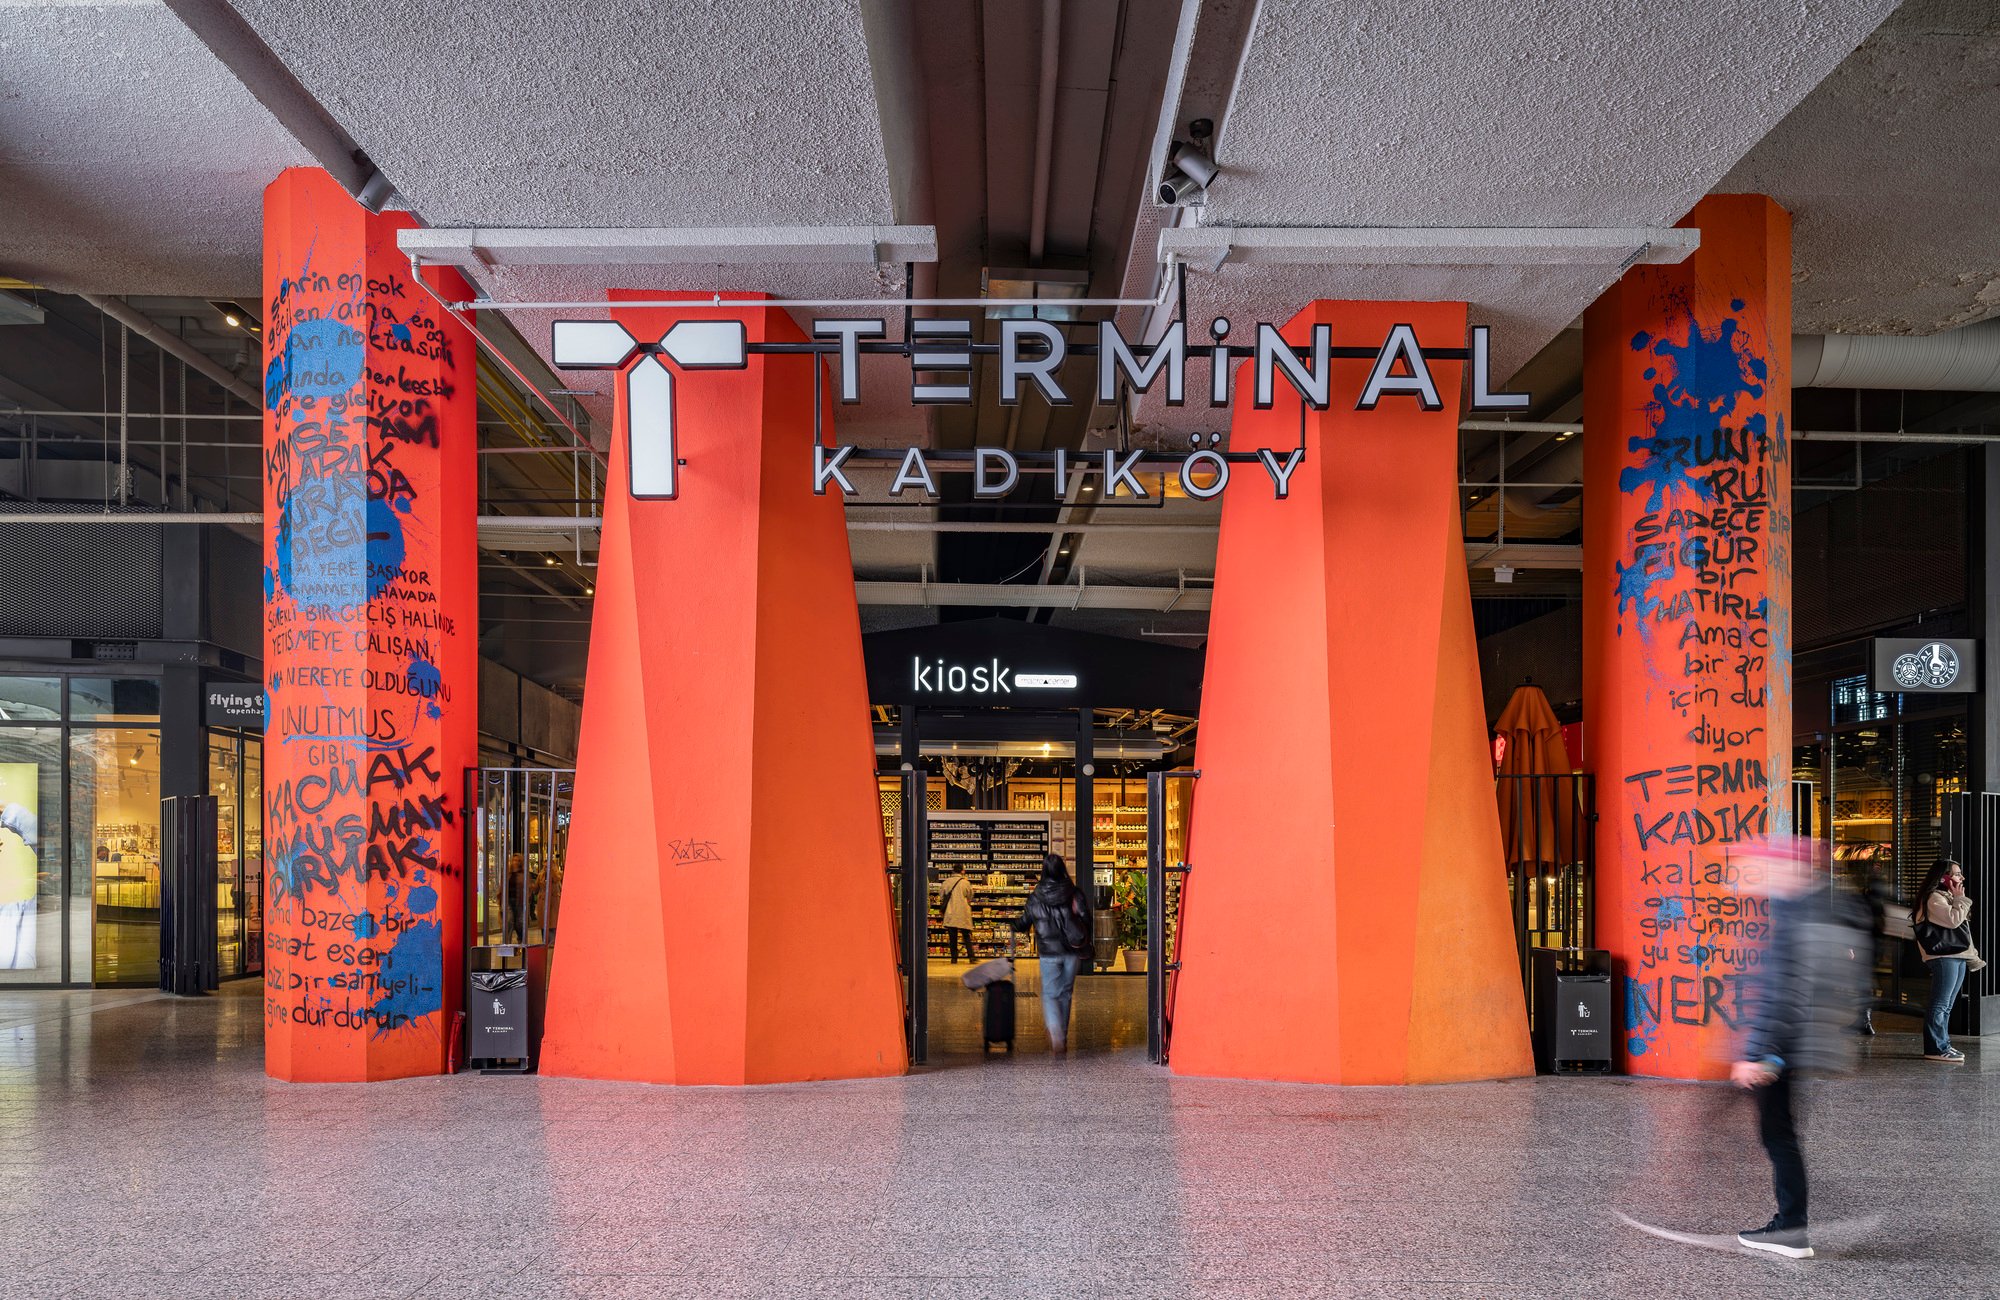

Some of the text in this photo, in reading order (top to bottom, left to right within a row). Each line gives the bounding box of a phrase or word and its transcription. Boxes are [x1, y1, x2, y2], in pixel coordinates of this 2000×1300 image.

[337, 273, 362, 291] en
[368, 274, 406, 299] çok
[338, 301, 398, 323] ama
[411, 313, 434, 329] en
[354, 415, 440, 449] TAM
[811, 431, 1307, 500] KADIKÖY
[1634, 508, 1765, 542] SADECE
[1696, 566, 1758, 589] bir
[376, 585, 437, 603] HAVADA
[402, 609, 456, 637] HALİNDE
[1679, 620, 1742, 649] Ama
[1684, 652, 1764, 677] bir an
[1920, 649, 1932, 662] AL
[286, 666, 354, 687] NEREYE
[361, 668, 451, 702] OLDUĞUNU
[914, 656, 1011, 694] kiosk
[209, 693, 253, 708] flying
[1669, 684, 1718, 717] için
[1685, 714, 1764, 753] diyor
[301, 900, 375, 935] bazen
[386, 904, 416, 934] bir
[267, 932, 318, 962] sanat
[1642, 944, 1669, 968] yu
